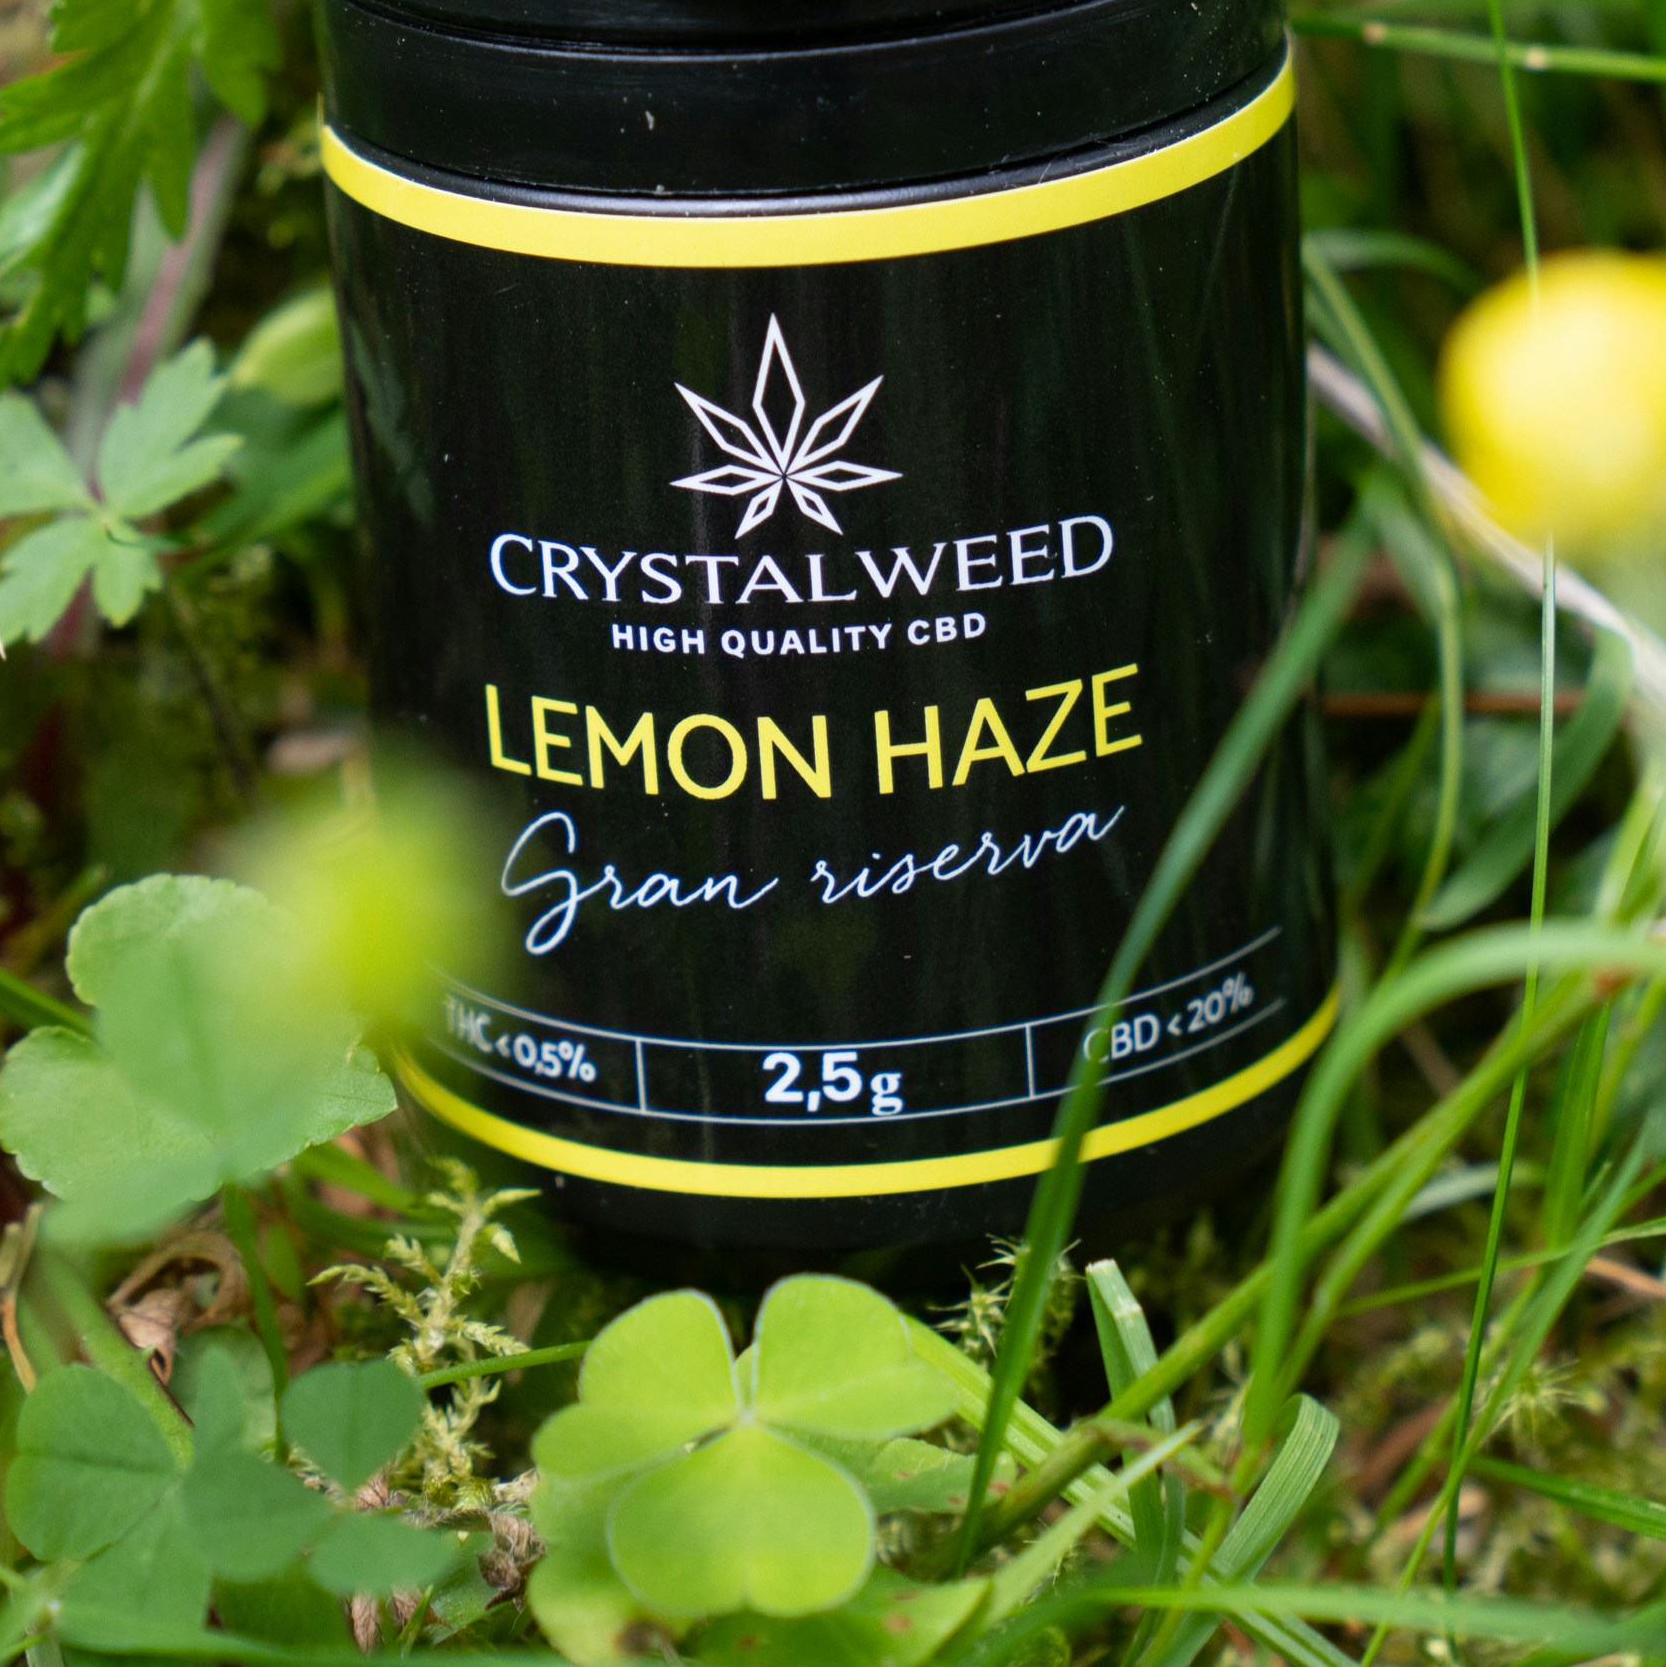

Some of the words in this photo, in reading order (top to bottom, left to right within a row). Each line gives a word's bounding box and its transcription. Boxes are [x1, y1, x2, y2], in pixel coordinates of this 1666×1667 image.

[490, 514, 1114, 605] CRYSTALWEED
[611, 623, 706, 655] HIGH
[720, 622, 893, 658] QUALITY
[907, 611, 986, 645] CBD
[485, 684, 832, 800] LEMON
[874, 663, 1142, 795] HAZE
[501, 811, 780, 955] Gran
[810, 805, 1125, 904] riserva
[1186, 971, 1255, 1033] 20%
